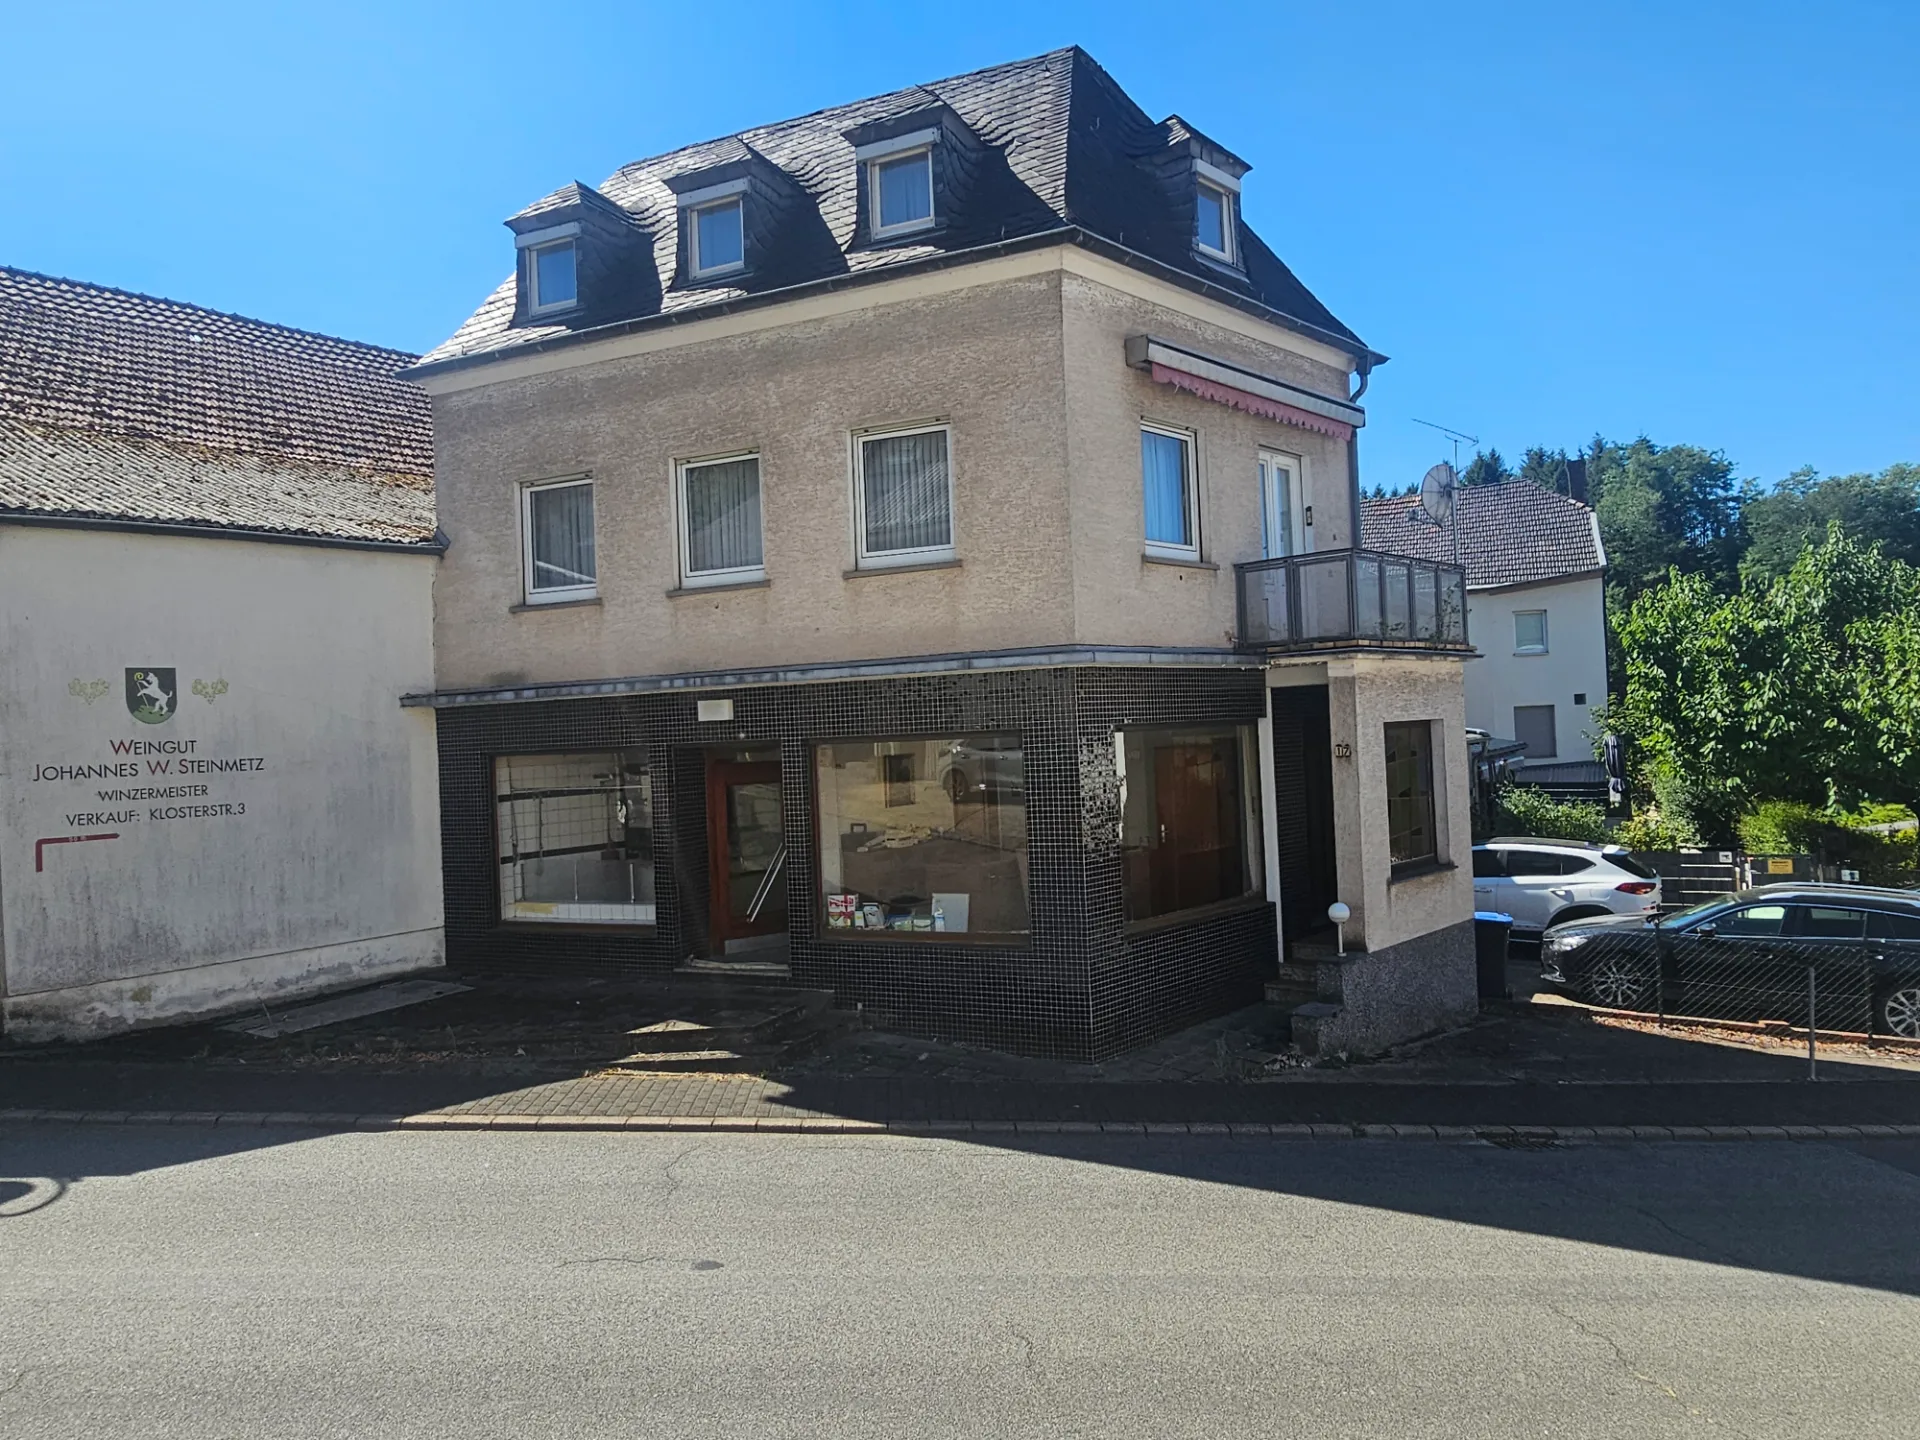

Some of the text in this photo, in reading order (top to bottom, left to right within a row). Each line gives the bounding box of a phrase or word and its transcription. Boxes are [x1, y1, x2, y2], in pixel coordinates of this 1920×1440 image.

[109, 739, 197, 756] WEINGUT
[33, 757, 265, 782] JOHANNES W. STEINMETZ
[97, 784, 209, 802] WINZERMEISTER
[65, 809, 141, 827] VERKAUF:
